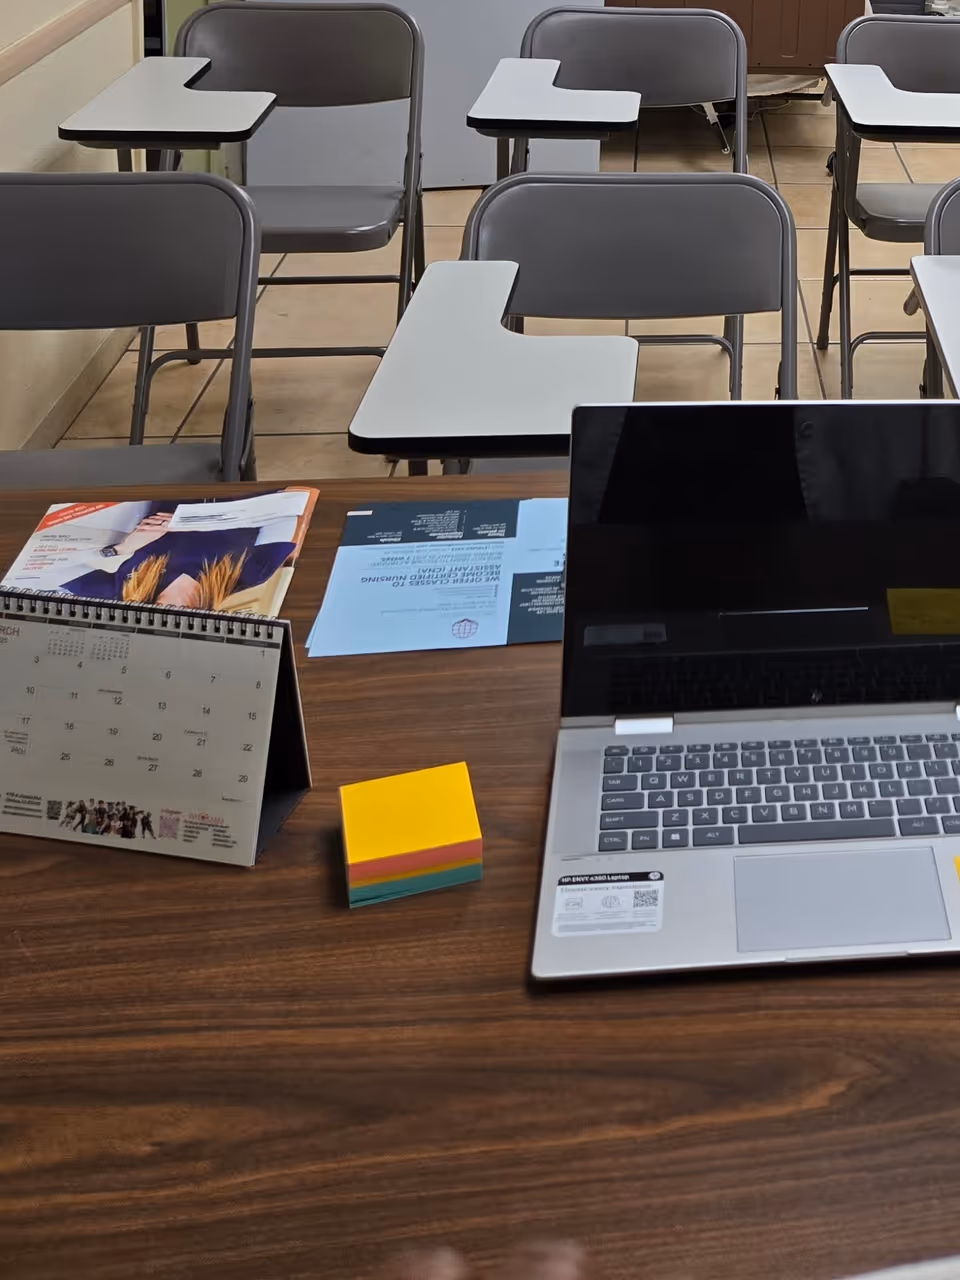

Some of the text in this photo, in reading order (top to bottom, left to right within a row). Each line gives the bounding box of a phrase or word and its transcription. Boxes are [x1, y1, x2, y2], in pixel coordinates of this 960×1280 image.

[448, 564, 501, 572] ASSISTANT
[361, 569, 501, 584] BECOME CERTIFIED NURSING
[451, 576, 483, 584] OFFER
[484, 575, 500, 583] WE
[408, 578, 450, 586] CLASSES
[121, 666, 126, 674] 5
[166, 671, 171, 679] 6
[211, 674, 216, 683] 7
[256, 681, 260, 689] 8
[158, 702, 166, 710] 13
[249, 712, 256, 720] 15
[152, 733, 162, 741] 20
[197, 738, 206, 746] 21
